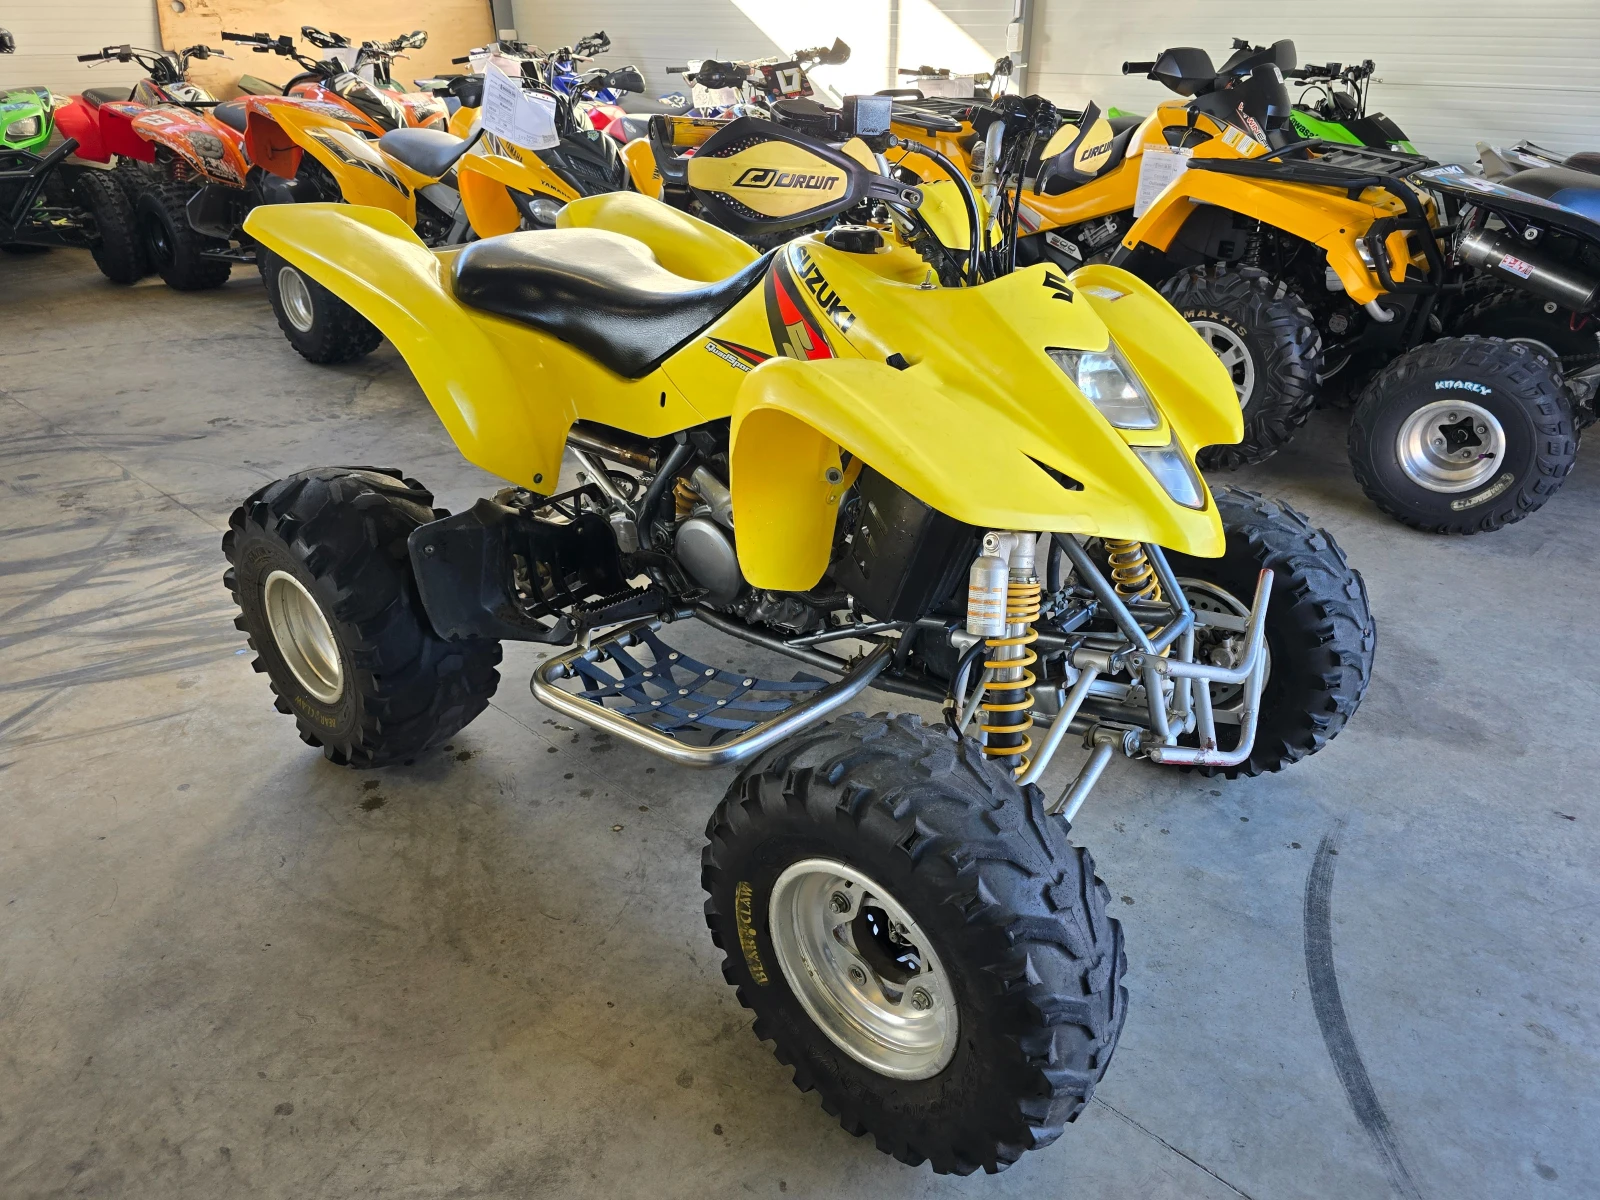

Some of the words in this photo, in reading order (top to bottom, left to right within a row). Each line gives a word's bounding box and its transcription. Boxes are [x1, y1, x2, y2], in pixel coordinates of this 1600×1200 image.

[505, 142, 523, 163] YAMAHA
[774, 172, 840, 190] CIRCUIT
[1420, 165, 1465, 178] SUZUKI
[540, 179, 573, 199] YAMAHA
[797, 246, 856, 334] SUZUKI
[1183, 309, 1248, 337] MAXXIS
[704, 342, 753, 373] QuadSpor
[1434, 380, 1492, 396] KNARLY
[294, 695, 315, 718] CLAW
[739, 881, 753, 925] CLAW
